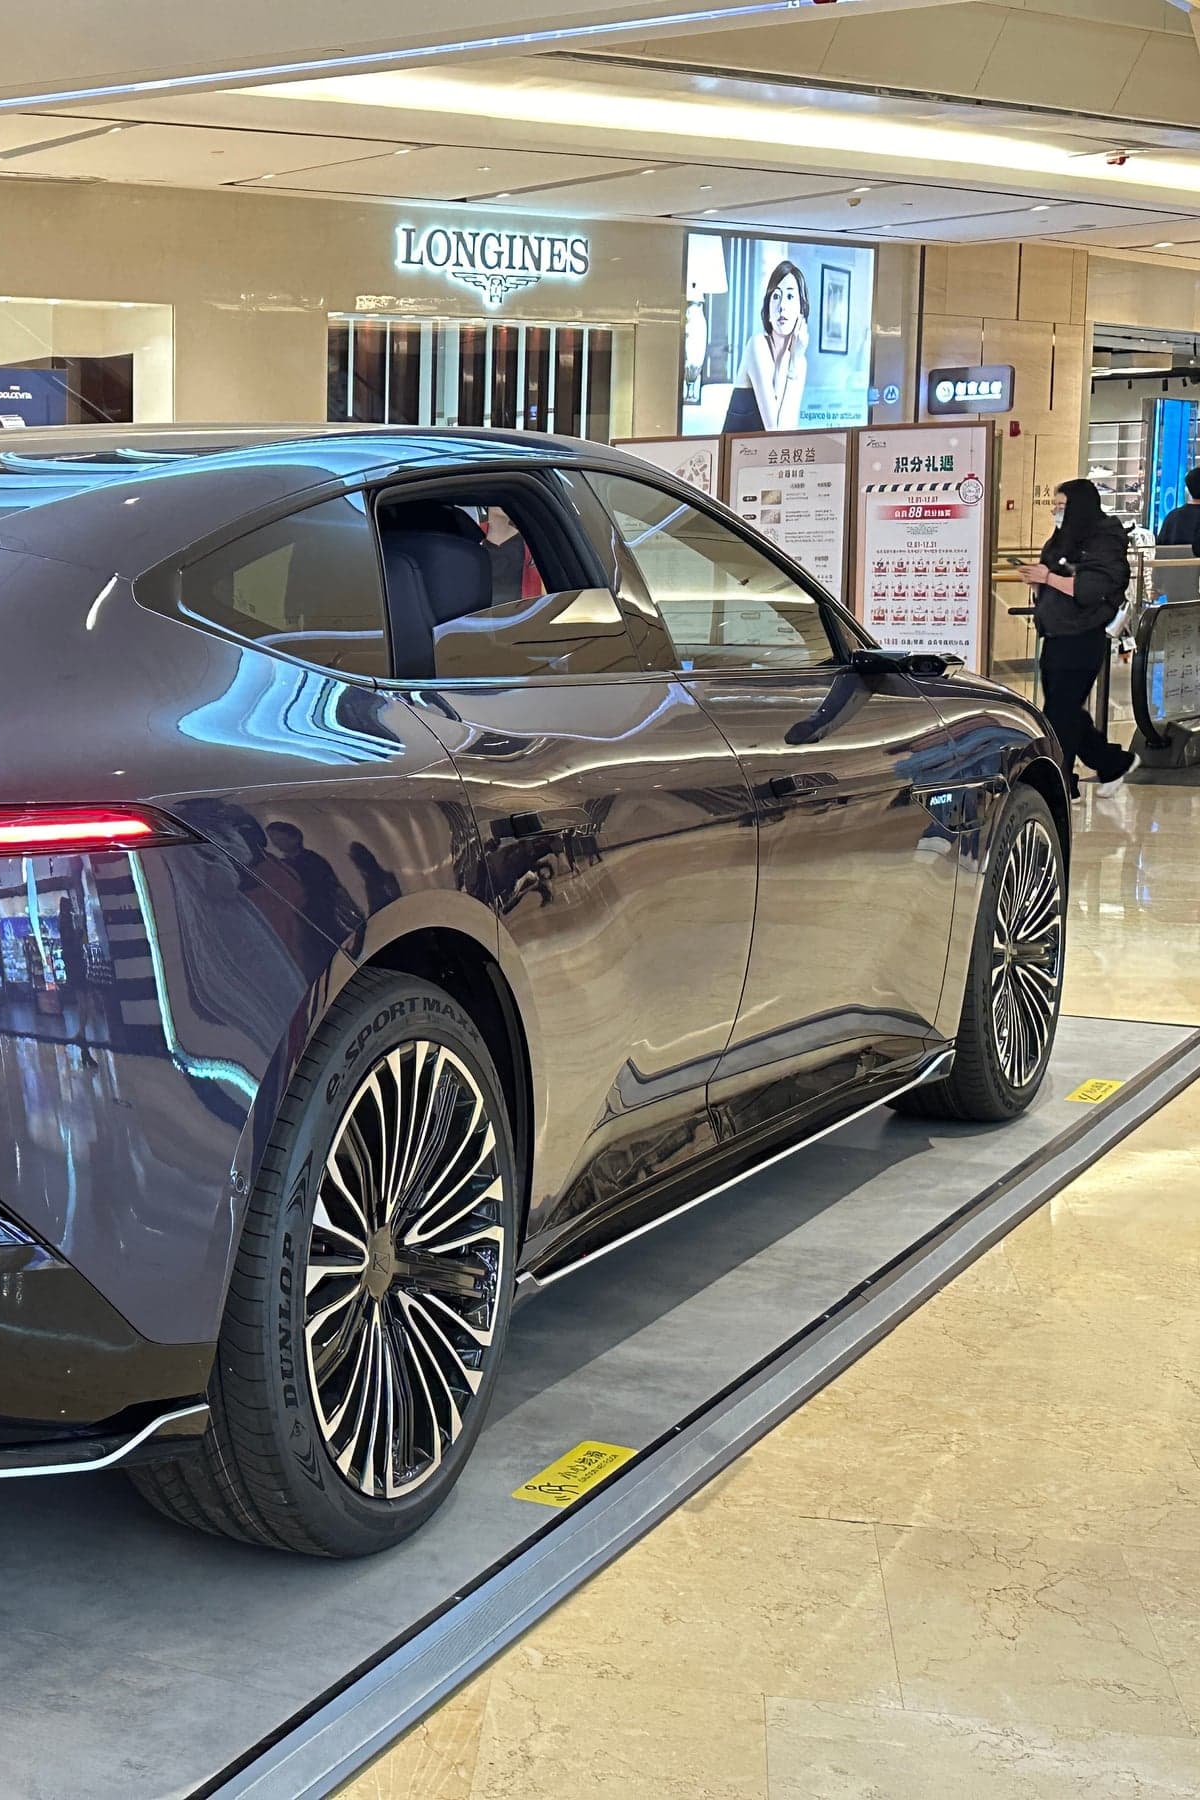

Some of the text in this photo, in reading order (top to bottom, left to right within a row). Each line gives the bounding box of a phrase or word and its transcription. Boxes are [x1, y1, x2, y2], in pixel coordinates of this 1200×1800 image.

[401, 227, 590, 275] LONGINES
[767, 447, 817, 465] 会员权益
[894, 455, 954, 473] 积分礼遇
[279, 1232, 299, 1409] DUNLOP
